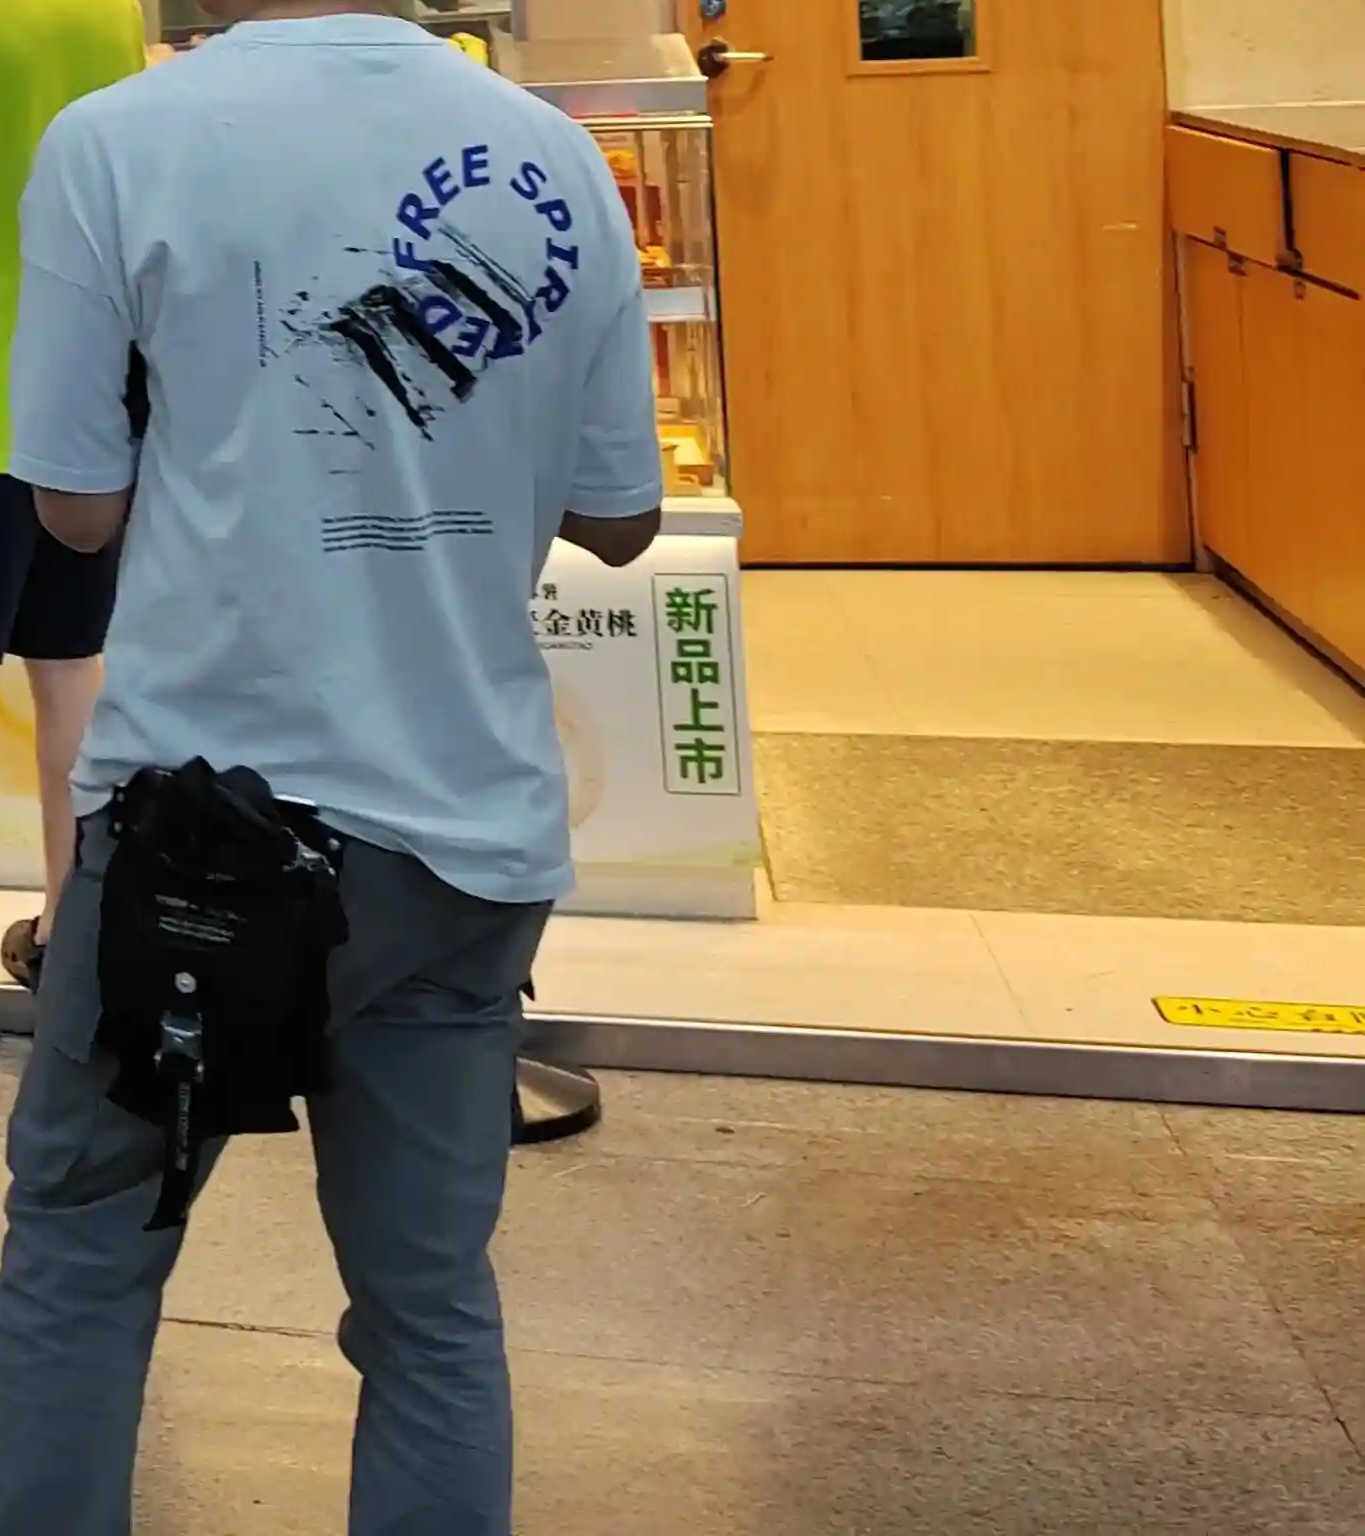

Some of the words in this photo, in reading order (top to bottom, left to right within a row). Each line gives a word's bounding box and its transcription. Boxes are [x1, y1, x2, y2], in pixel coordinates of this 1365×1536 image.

[392, 144, 491, 273] FREE
[530, 607, 639, 639] 金黄桃
[664, 587, 727, 785] 新品上市
